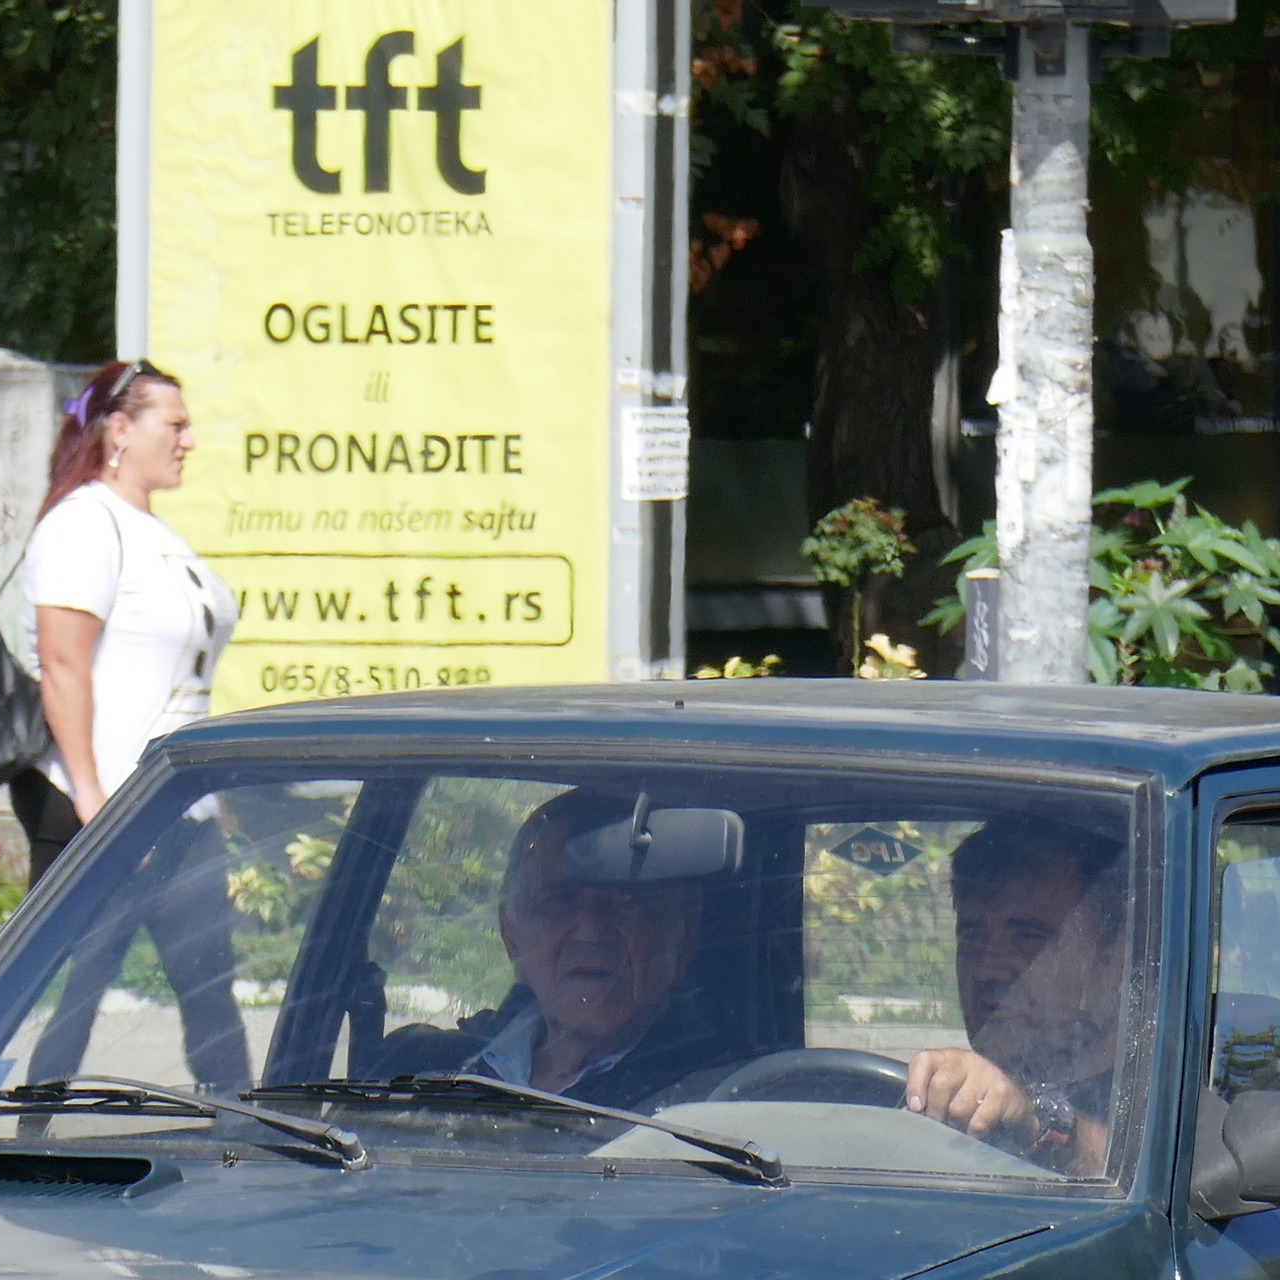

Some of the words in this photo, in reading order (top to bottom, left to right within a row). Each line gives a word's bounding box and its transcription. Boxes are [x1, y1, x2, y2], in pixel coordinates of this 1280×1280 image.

[273, 30, 487, 196] tft
[267, 211, 494, 237] TELEFONOTEKA
[265, 302, 495, 345] OGLASITE
[363, 371, 391, 403] ili
[245, 432, 524, 474] PRONAĐITE
[225, 501, 304, 537] firmu
[312, 508, 347, 532] na
[357, 502, 453, 532] našem
[463, 502, 537, 540] sajtu
[237, 575, 543, 623] ww.tft.rs
